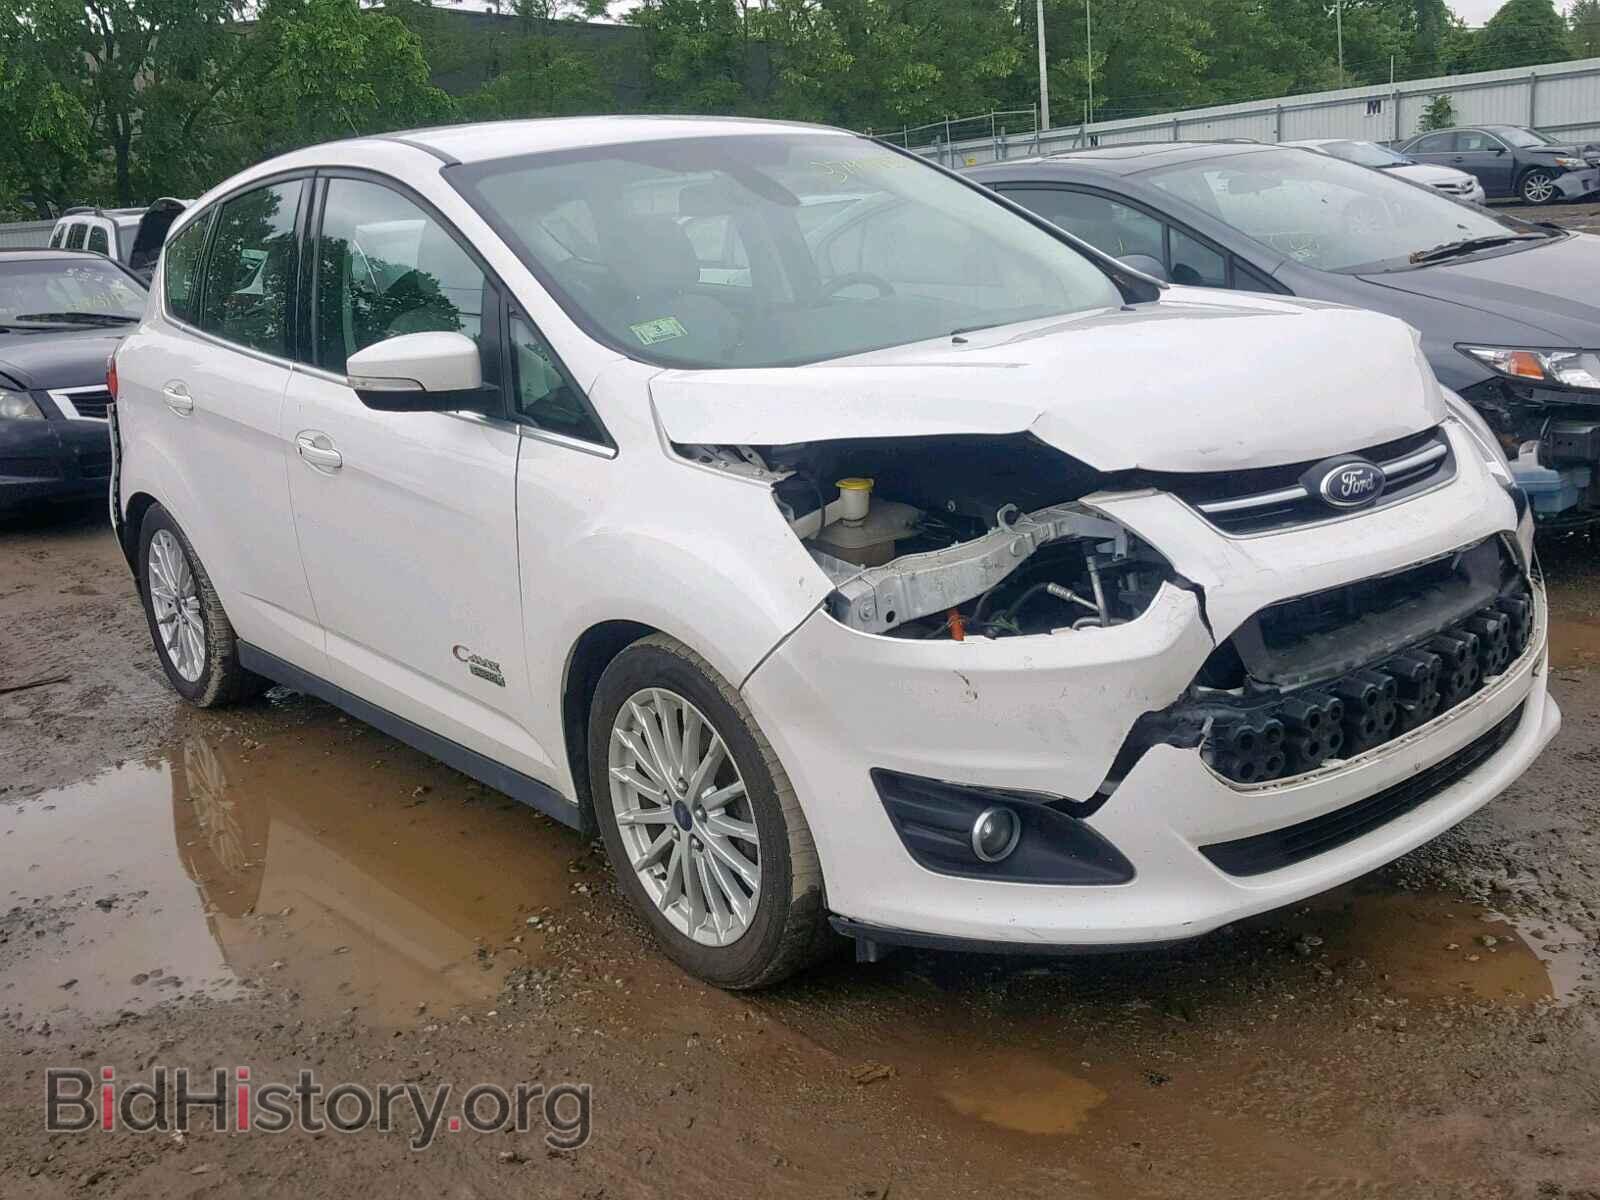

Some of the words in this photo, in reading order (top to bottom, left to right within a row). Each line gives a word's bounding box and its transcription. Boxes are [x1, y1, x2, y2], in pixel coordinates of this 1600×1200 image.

[1366, 100, 1381, 114] M
[1090, 135, 1099, 147] N
[1340, 468, 1375, 497] Ford
